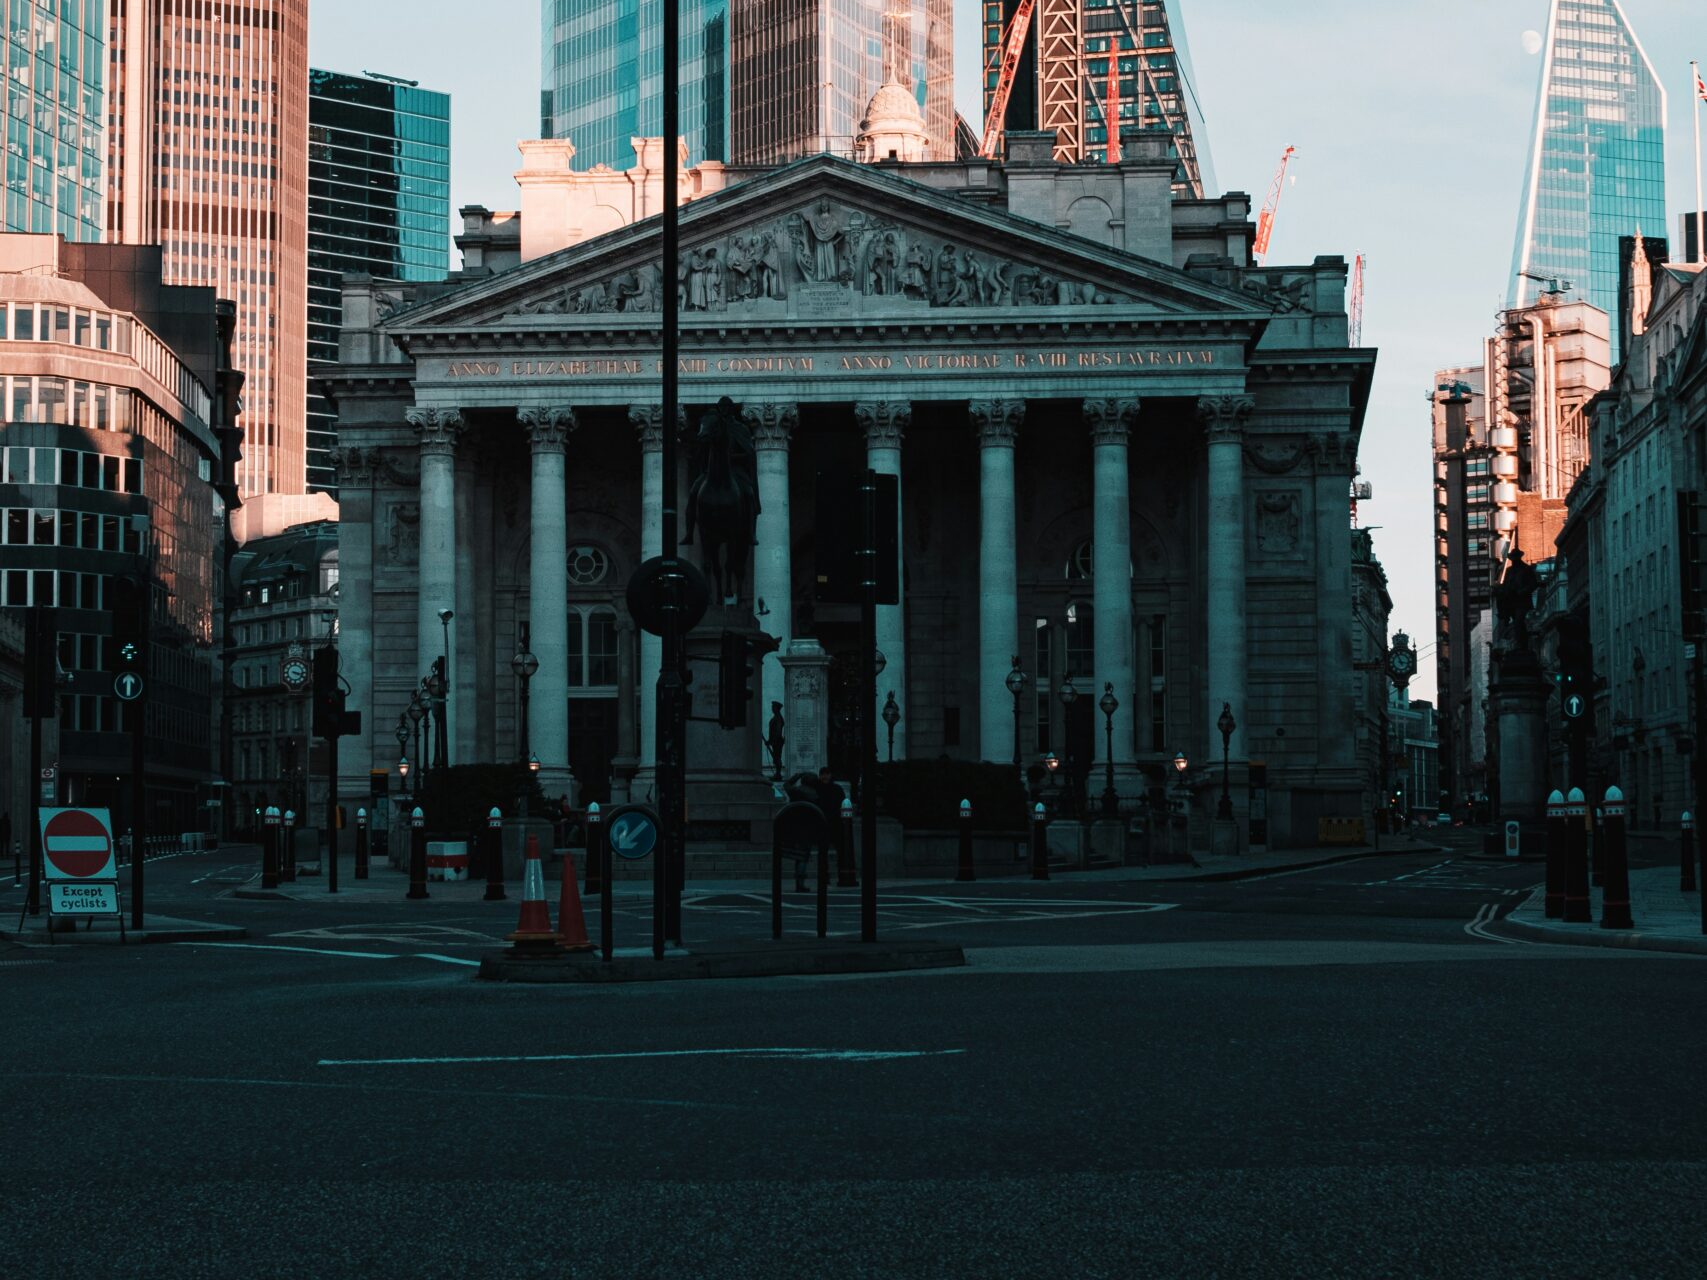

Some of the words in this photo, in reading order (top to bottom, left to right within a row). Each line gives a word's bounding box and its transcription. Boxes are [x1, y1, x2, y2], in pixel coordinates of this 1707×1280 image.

[445, 361, 499, 376] ANNO
[513, 360, 643, 375] ELIZABETHAE
[718, 357, 813, 371] CONDITVM
[837, 355, 891, 369] ANNO
[904, 354, 1002, 368] VICTORIAE
[1015, 353, 1025, 367] R
[1038, 352, 1065, 366] VIII
[1079, 351, 1213, 366] RESTAVRATVM
[62, 886, 103, 898] Except
[61, 898, 107, 910] cyclists
